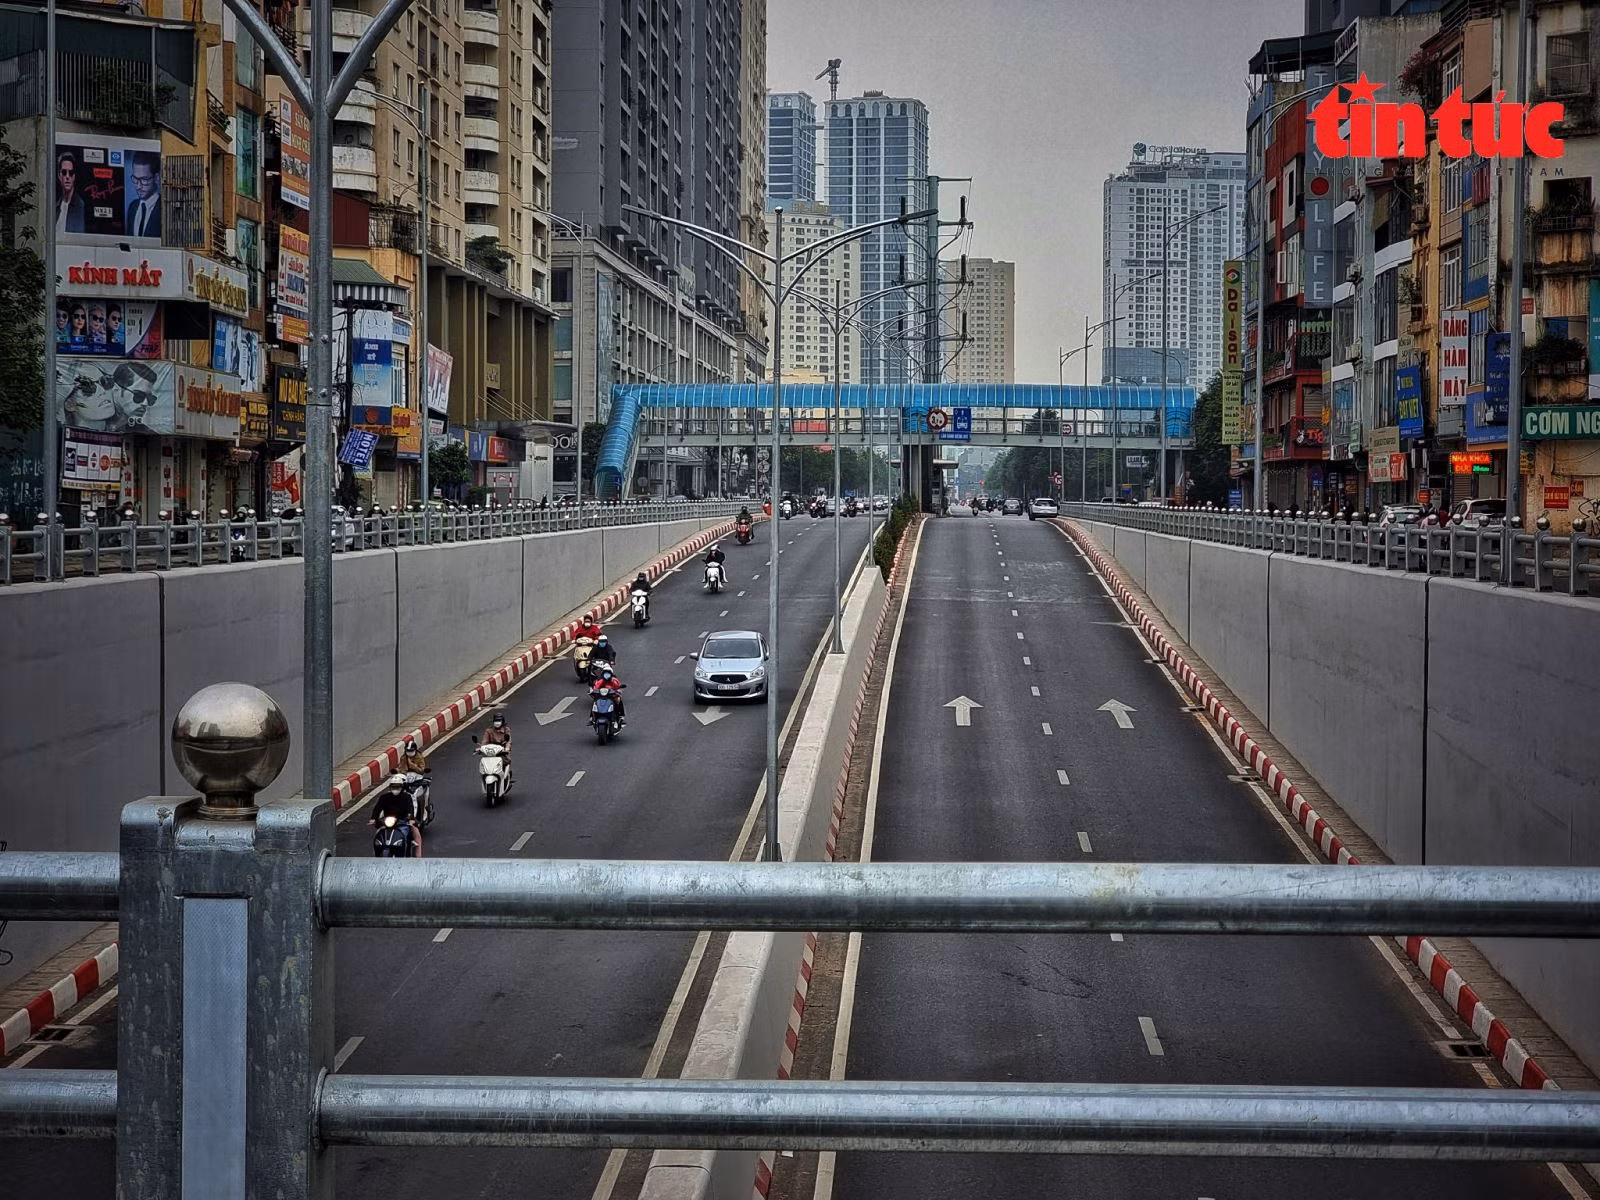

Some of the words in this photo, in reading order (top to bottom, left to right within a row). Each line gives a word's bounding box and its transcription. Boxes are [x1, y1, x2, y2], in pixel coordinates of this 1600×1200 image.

[1313, 203, 1325, 300] LIFE
[69, 261, 118, 286] KÍNH
[122, 260, 163, 287] MẮT
[1443, 316, 1467, 337] RĂNG
[1444, 345, 1466, 367] HÀM
[1444, 376, 1466, 401] MẶT
[1525, 410, 1569, 435] CƠM
[354, 433, 373, 464] HOTEL
[1469, 453, 1489, 463] KHOA
